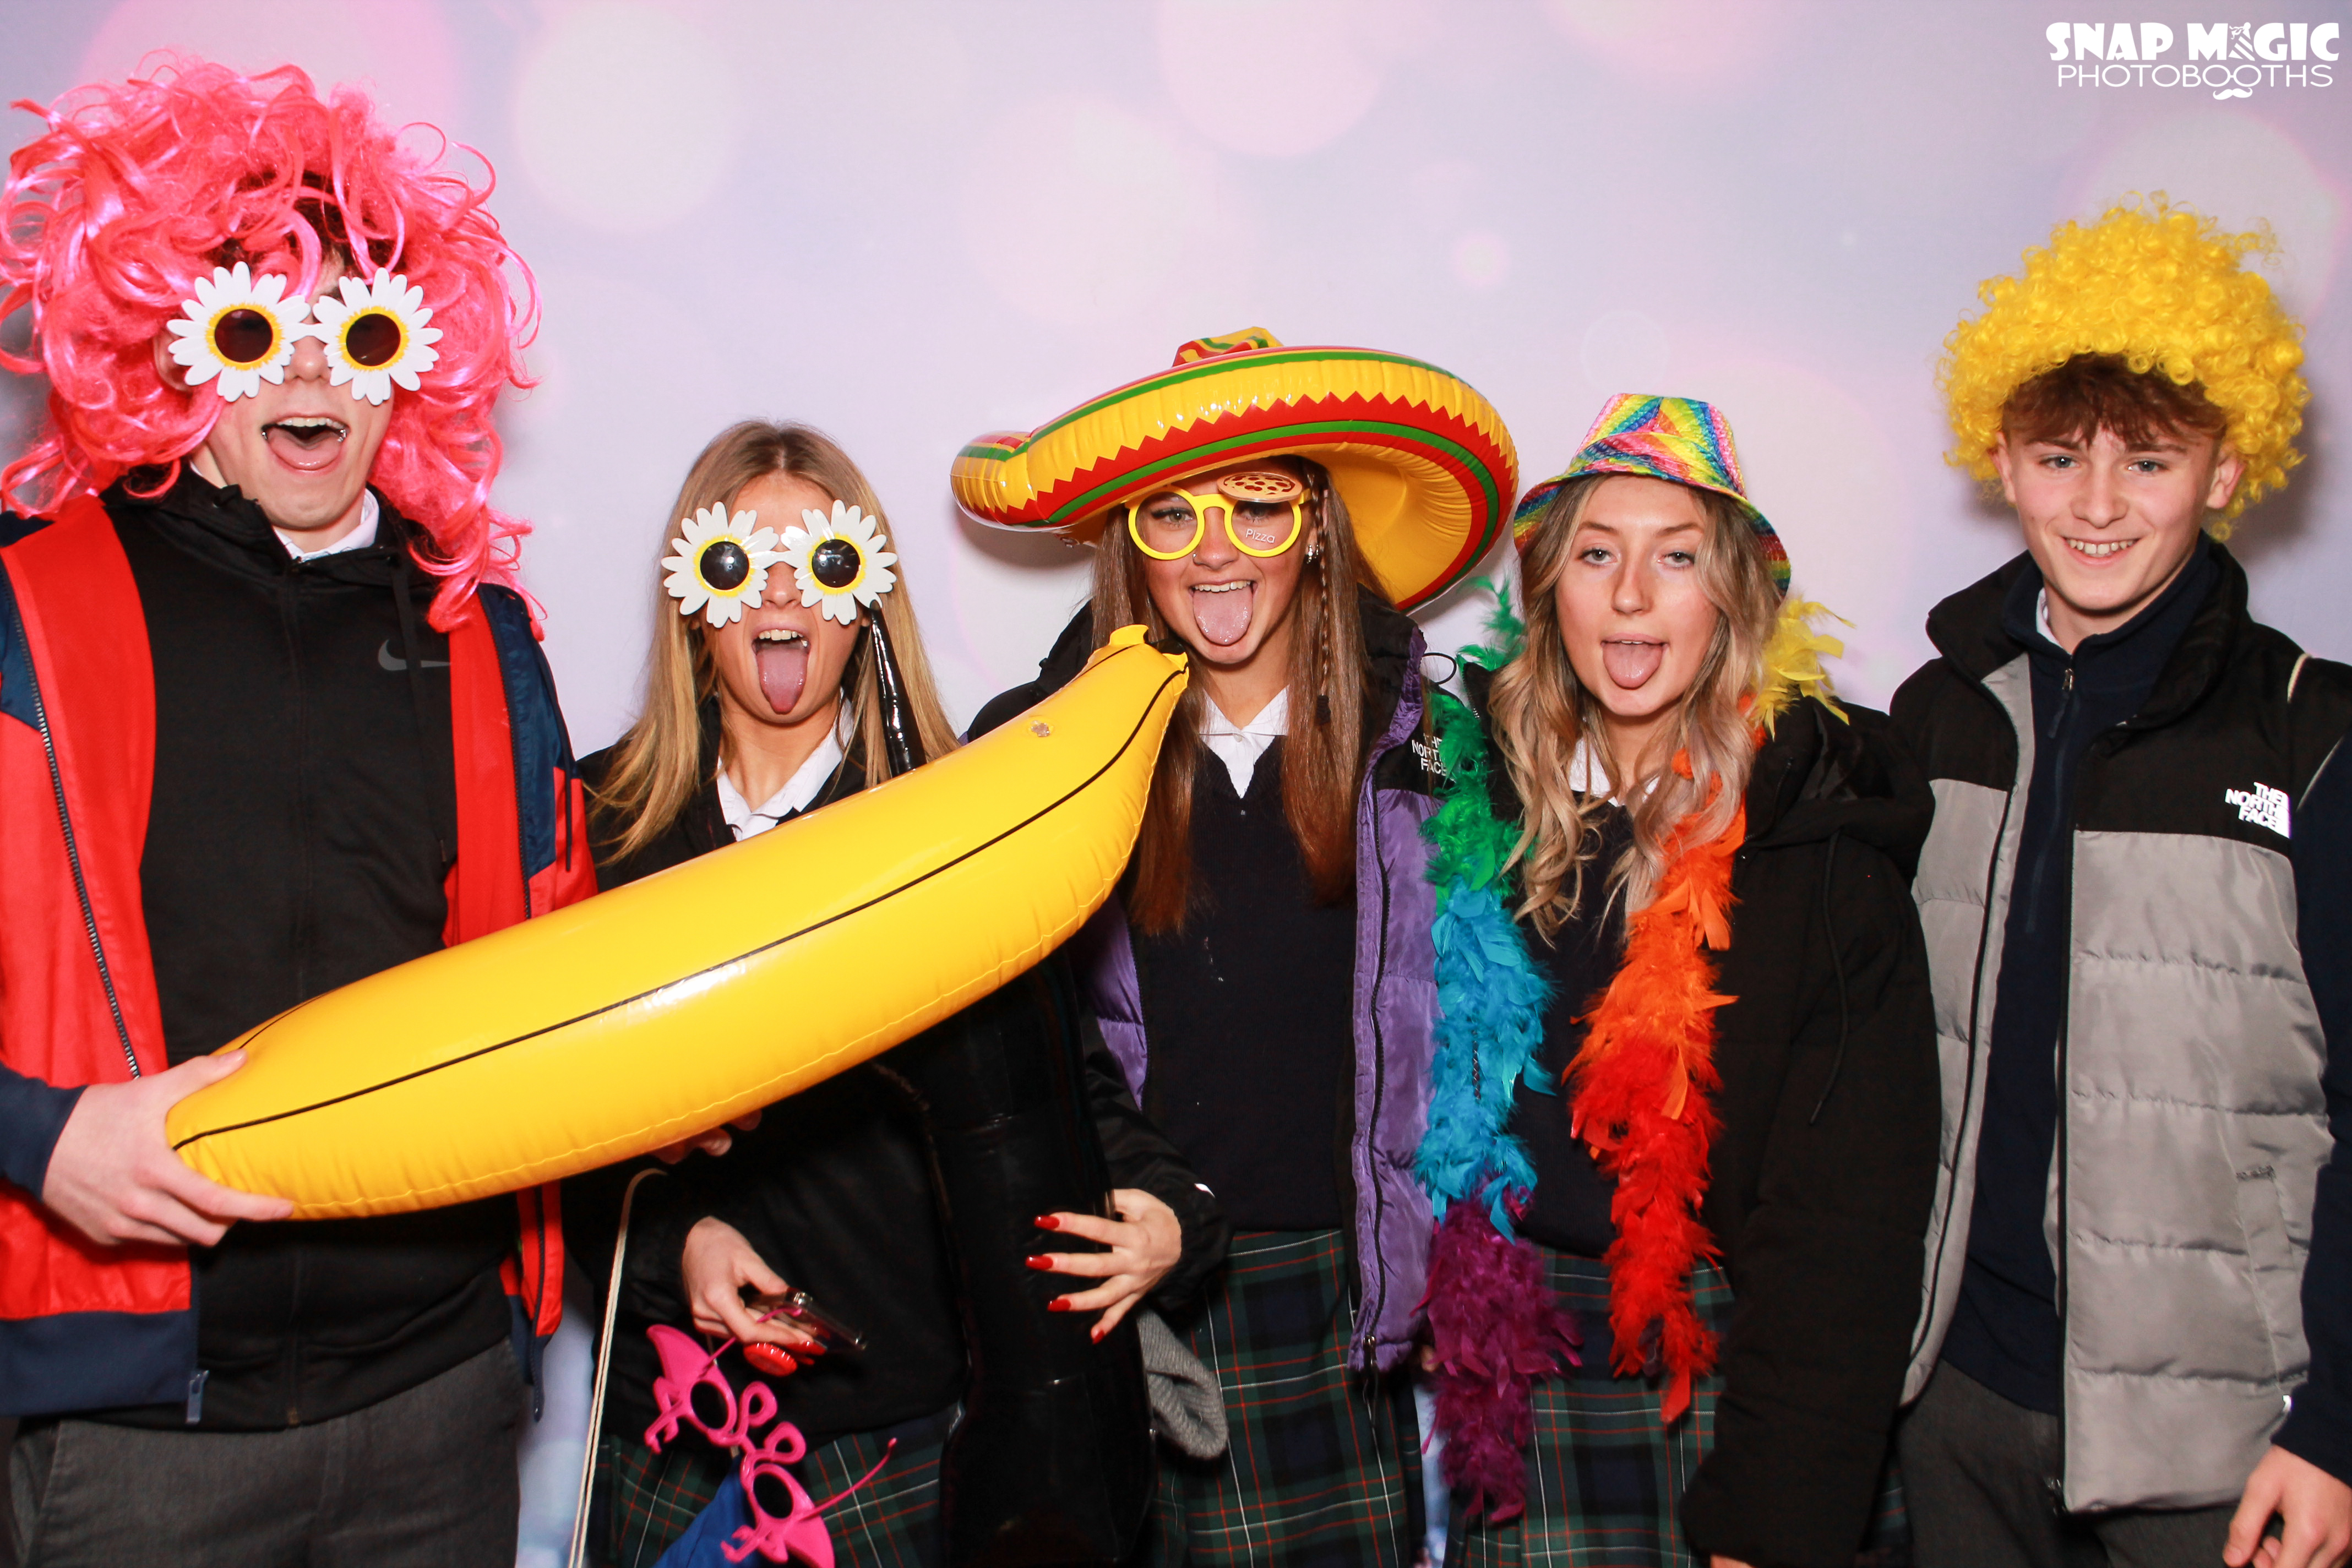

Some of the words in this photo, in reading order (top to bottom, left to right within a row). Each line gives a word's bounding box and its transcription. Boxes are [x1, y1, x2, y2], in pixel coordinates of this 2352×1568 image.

[1245, 528, 1275, 543] Pizza
[2225, 788, 2282, 818] NORTH
[2253, 782, 2283, 802] THE
[2238, 805, 2278, 829] FACE
